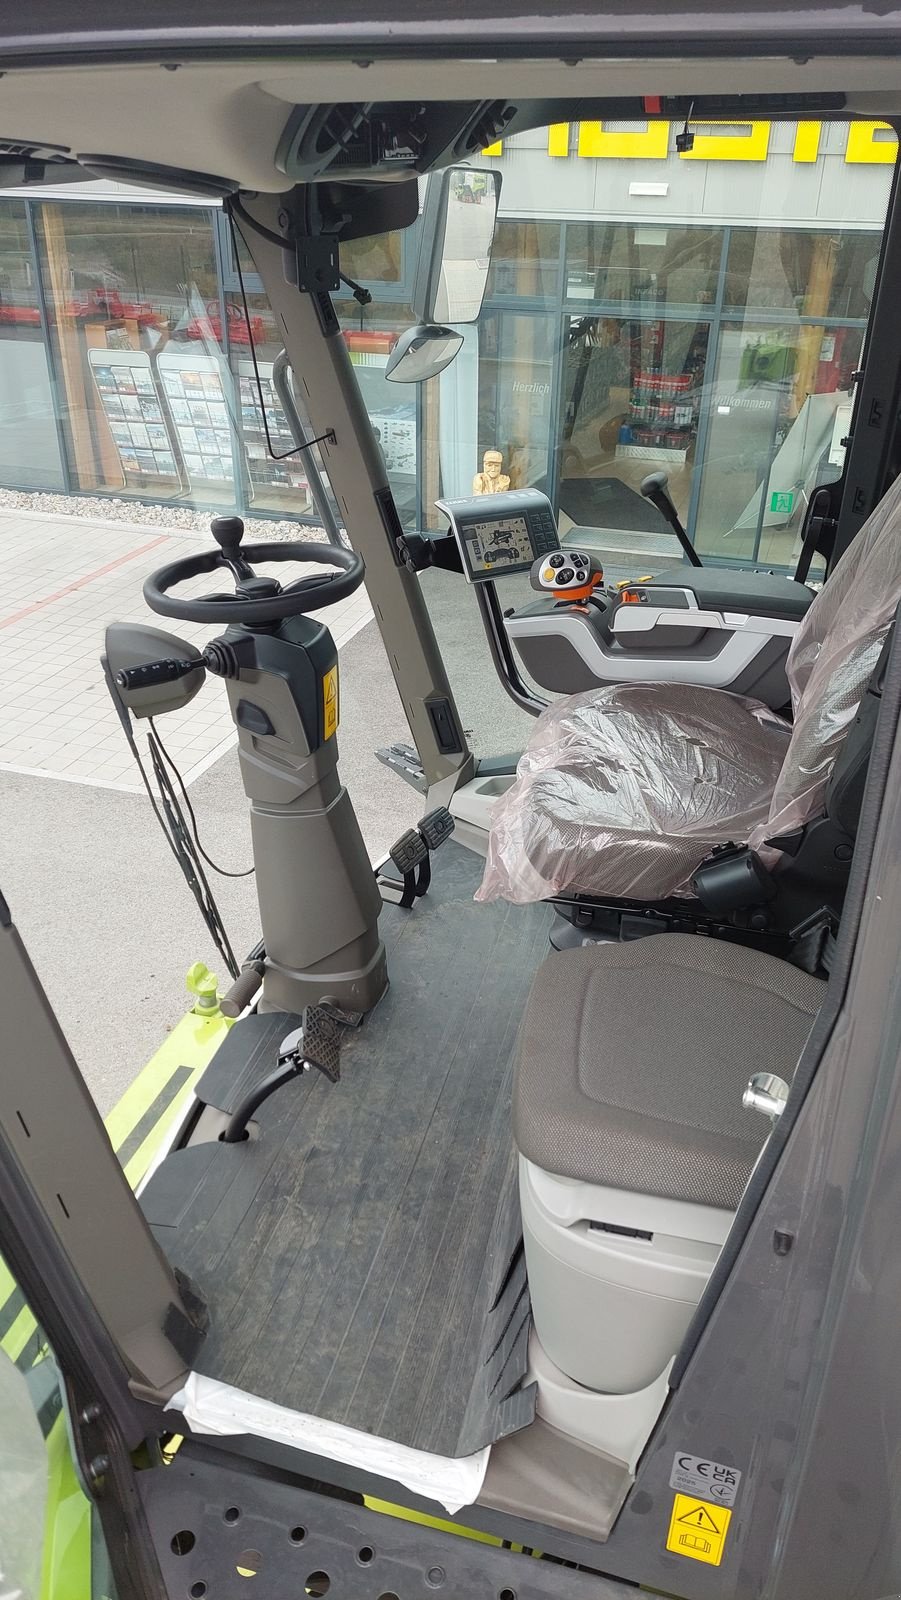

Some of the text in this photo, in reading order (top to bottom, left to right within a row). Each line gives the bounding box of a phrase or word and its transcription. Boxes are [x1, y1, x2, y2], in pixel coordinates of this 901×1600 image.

[512, 381, 550, 393] Herzlich
[678, 1457, 711, 1477] CE
[714, 1466, 737, 1479] UK
